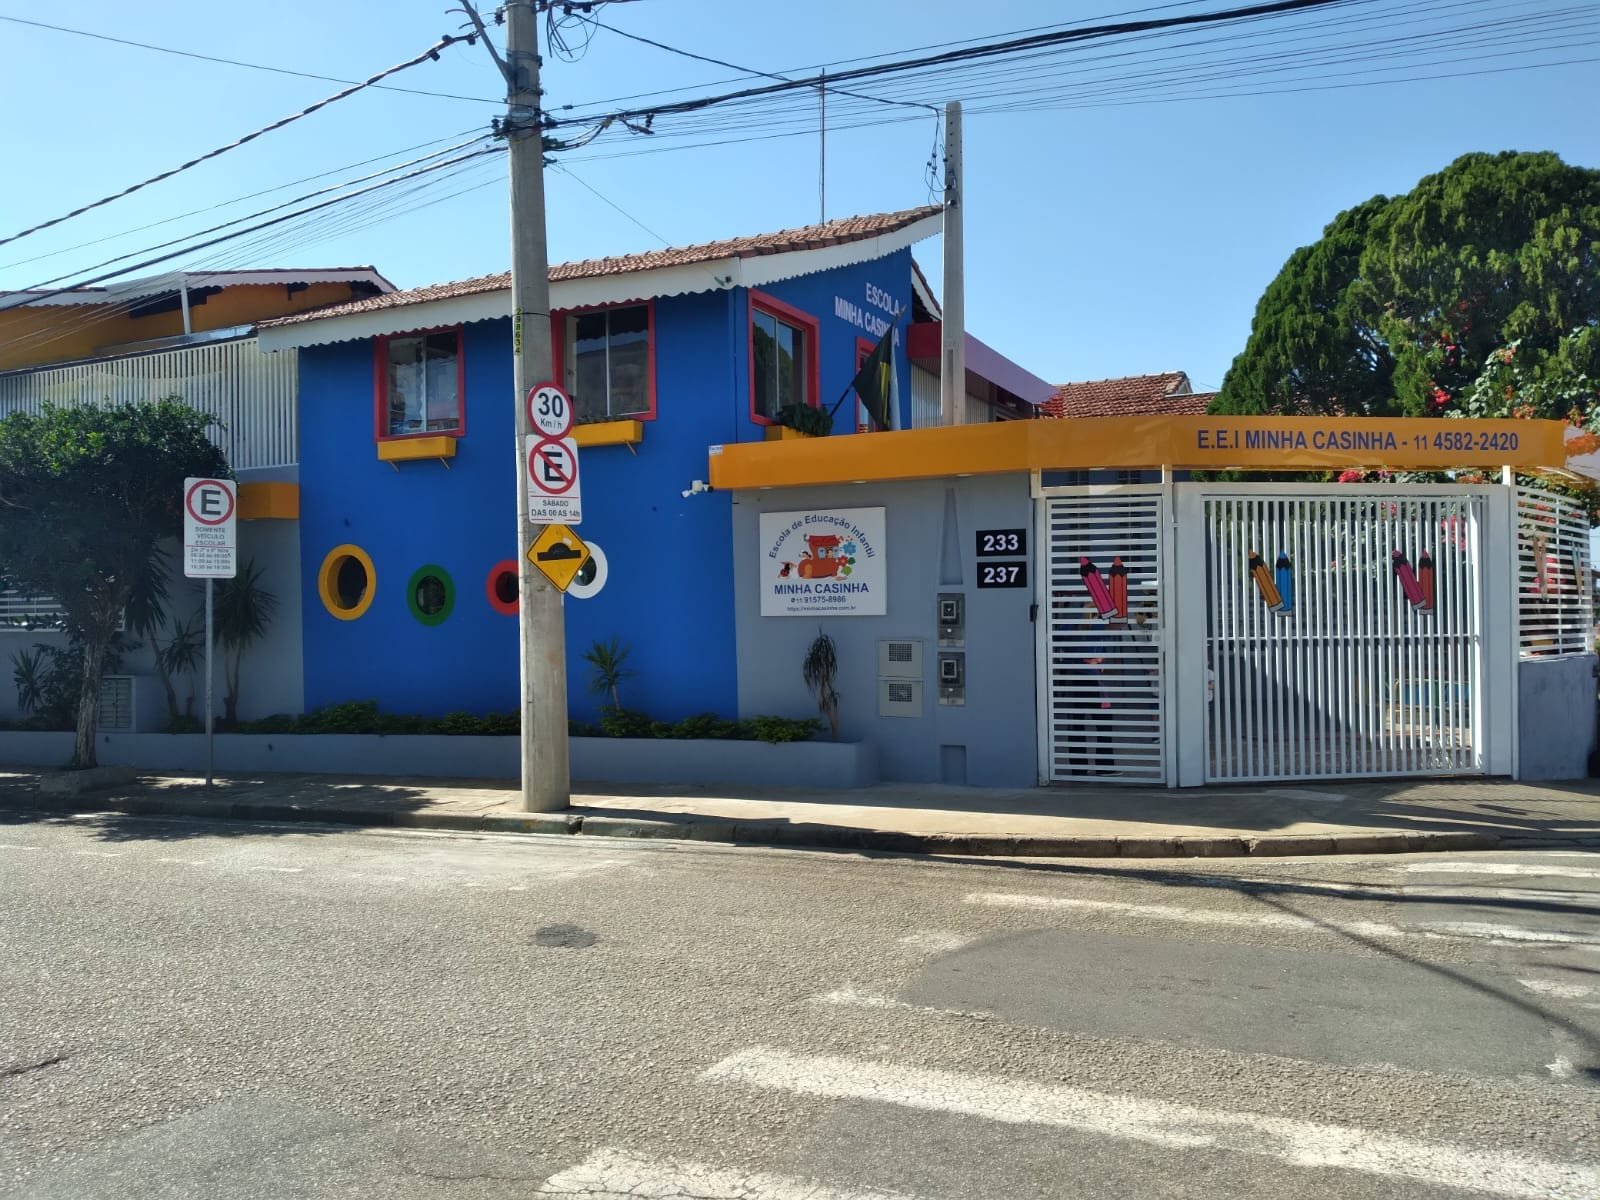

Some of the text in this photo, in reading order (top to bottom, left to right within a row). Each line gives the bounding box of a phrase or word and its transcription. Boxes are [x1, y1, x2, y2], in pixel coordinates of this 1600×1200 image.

[866, 282, 900, 317] ESCOLA
[835, 295, 900, 347] MINHA CASINA
[538, 392, 563, 418] 30
[1197, 430, 1239, 449] E.E.I
[1245, 430, 1307, 449] MINHA
[1312, 431, 1397, 450] CASINHA
[1413, 435, 1428, 450] 11
[1433, 431, 1519, 451] 4582-2420
[201, 489, 222, 516] E
[531, 508, 547, 517] DAS
[769, 514, 876, 559] Escola de Educação Infantil
[983, 534, 1019, 551] 233
[983, 566, 1019, 583] 237
[774, 582, 869, 595] MINHA CASINHA
